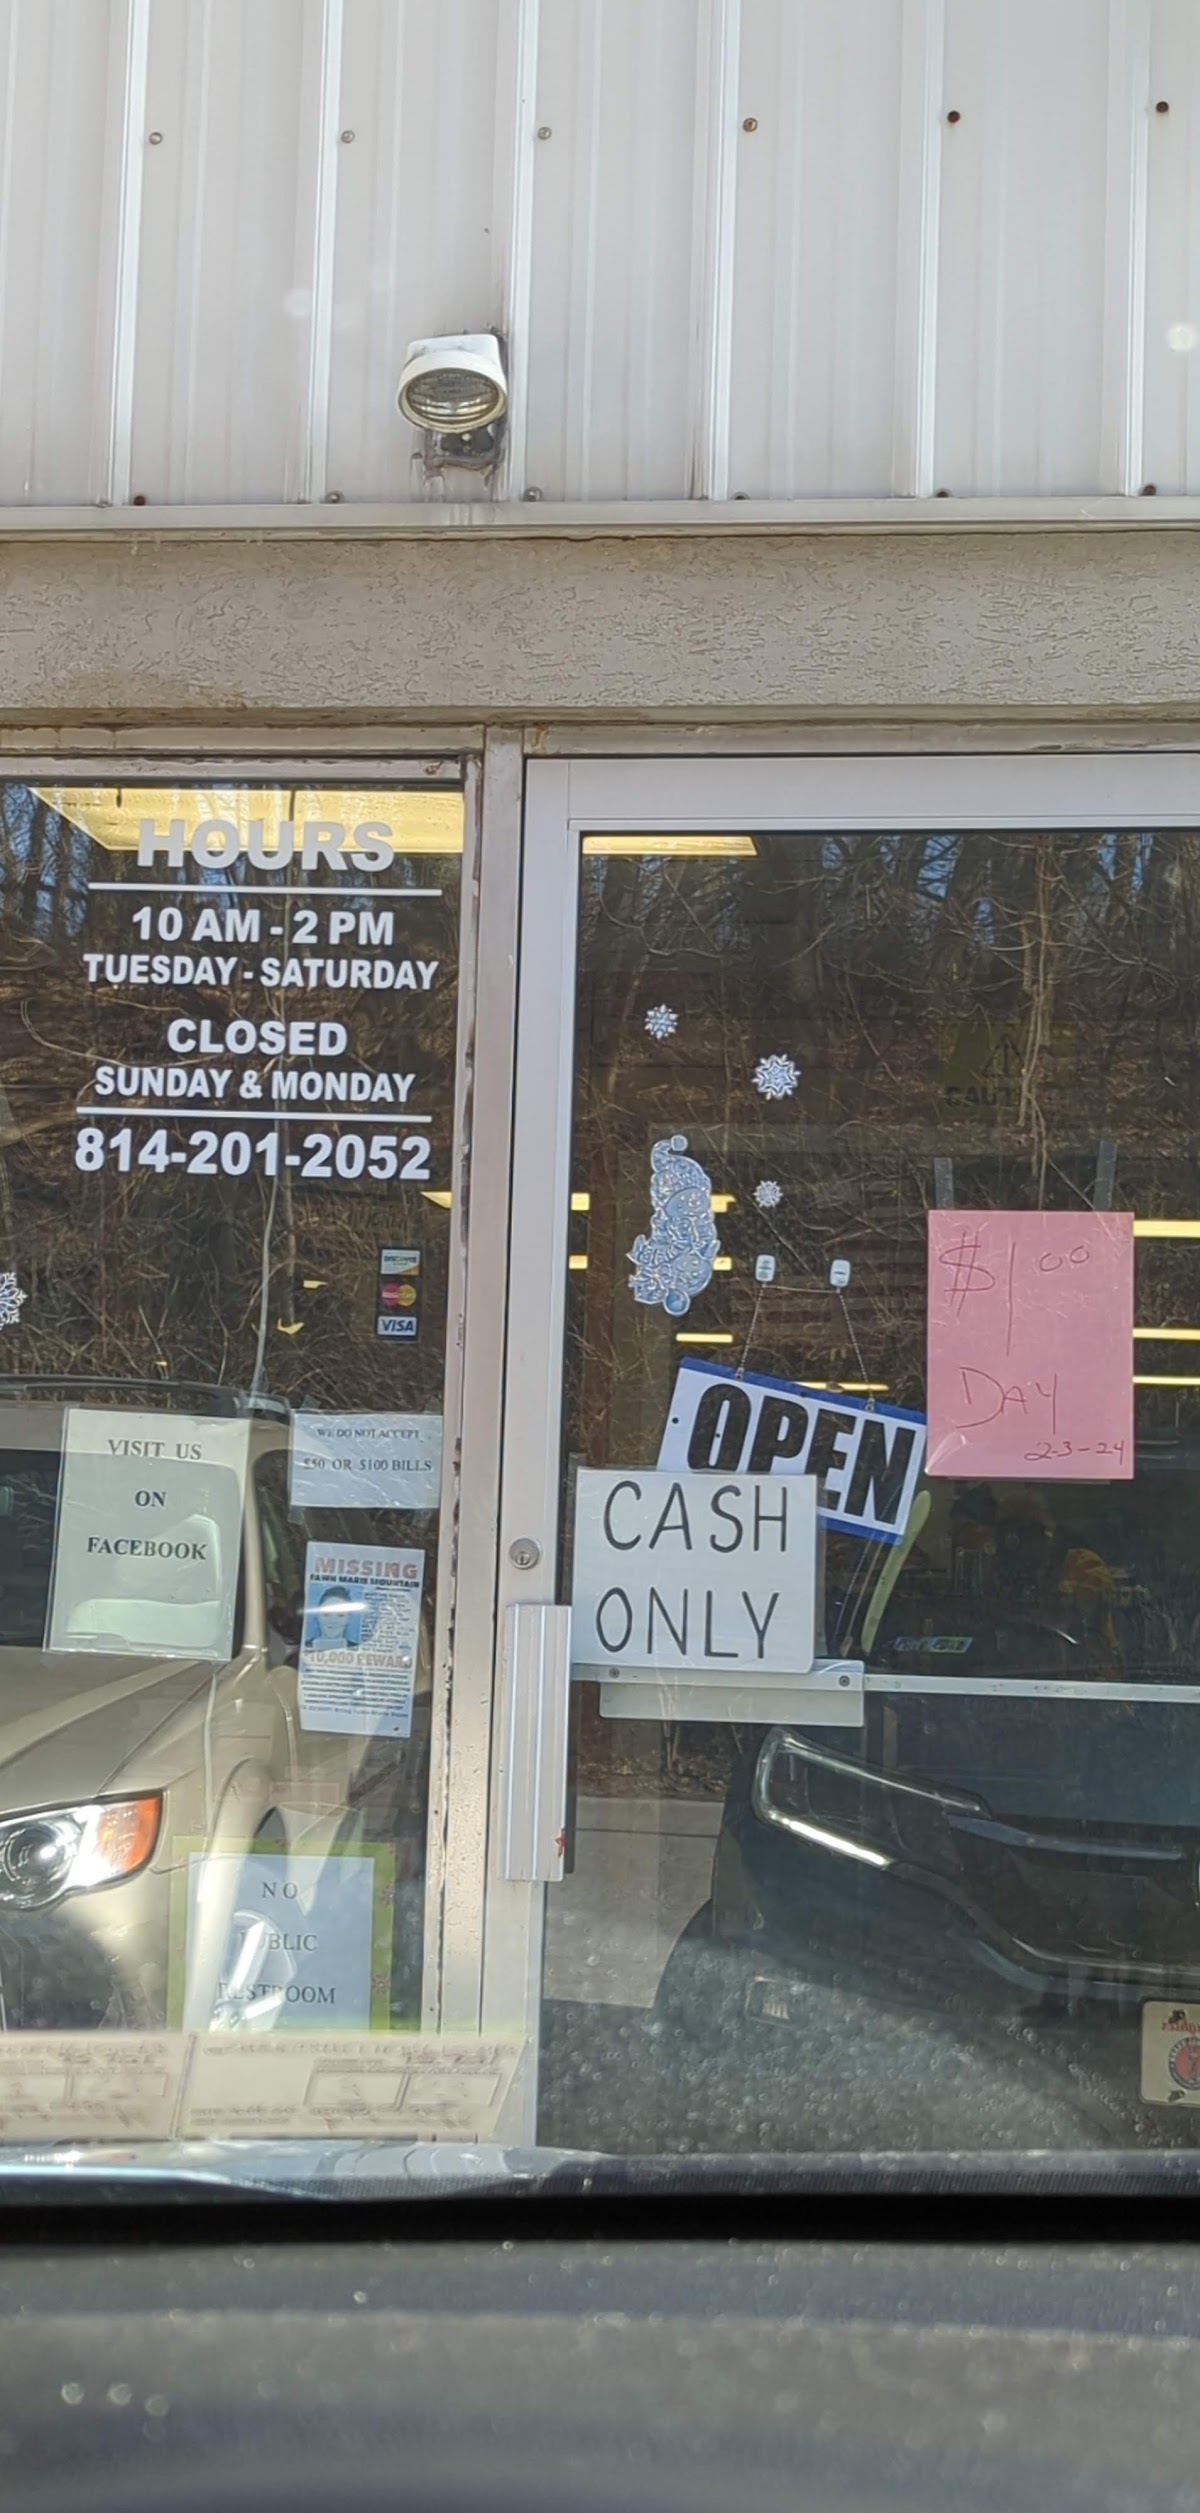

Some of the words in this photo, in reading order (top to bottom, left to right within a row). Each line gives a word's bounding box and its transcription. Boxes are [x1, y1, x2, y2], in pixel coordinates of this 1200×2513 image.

[137, 819, 395, 872] HOURS
[132, 907, 183, 942] 10
[191, 909, 260, 943] AM
[293, 911, 318, 944] 2
[329, 912, 393, 945] PM
[83, 954, 238, 986] TUESDAY
[260, 957, 439, 990] SATURDAY
[167, 1019, 348, 1056] CLOSED
[94, 1066, 231, 1098] SUNDAY
[240, 1073, 263, 1099] &
[271, 1072, 415, 1103] MONDAY
[74, 1127, 432, 1181] 814-201-2052
[382, 1319, 414, 1332] VISA
[954, 1366, 1058, 1436] DAY
[336, 1428, 352, 1438] DO
[354, 1429, 376, 1438] NOT
[379, 1429, 419, 1438] ACCEPT
[108, 1439, 165, 1458] VISIT
[175, 1443, 202, 1460] US
[687, 1382, 917, 1525] OPEN
[331, 1459, 352, 1470] OR
[359, 1459, 389, 1471] $100
[391, 1460, 433, 1471] BILLS
[134, 1490, 167, 1507] ON
[603, 1479, 788, 1553] CASH
[87, 1536, 207, 1560] FACEBOOK
[315, 1557, 418, 1580] MISSING
[596, 1586, 780, 1659] ONLY
[357, 1654, 413, 1669] REWARD
[262, 1882, 298, 1899] NO
[241, 1932, 318, 1951] BLIC
